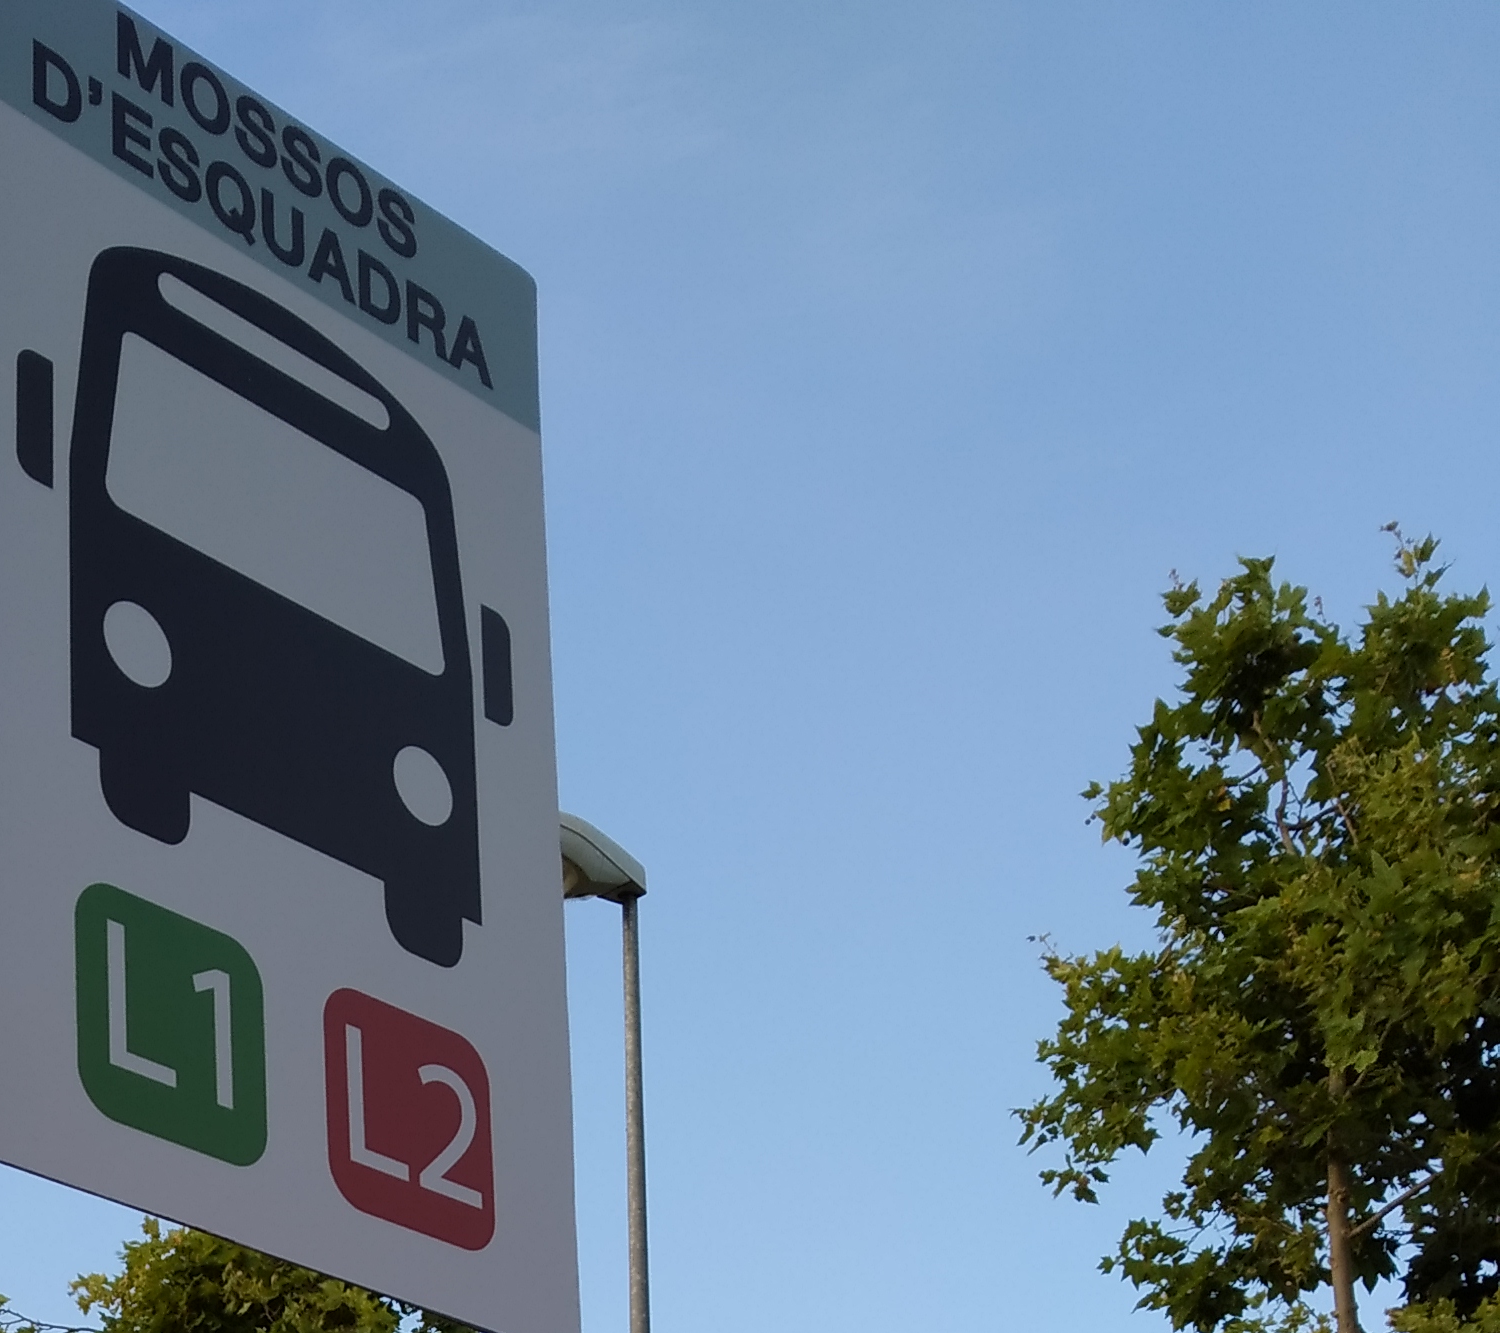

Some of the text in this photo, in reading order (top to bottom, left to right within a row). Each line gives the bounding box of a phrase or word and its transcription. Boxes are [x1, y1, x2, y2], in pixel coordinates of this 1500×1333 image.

[32, 38, 493, 390] D'ESQUADRA
[117, 12, 417, 258] MOSSOS
[107, 918, 233, 1109] L1
[346, 1023, 482, 1209] L2
